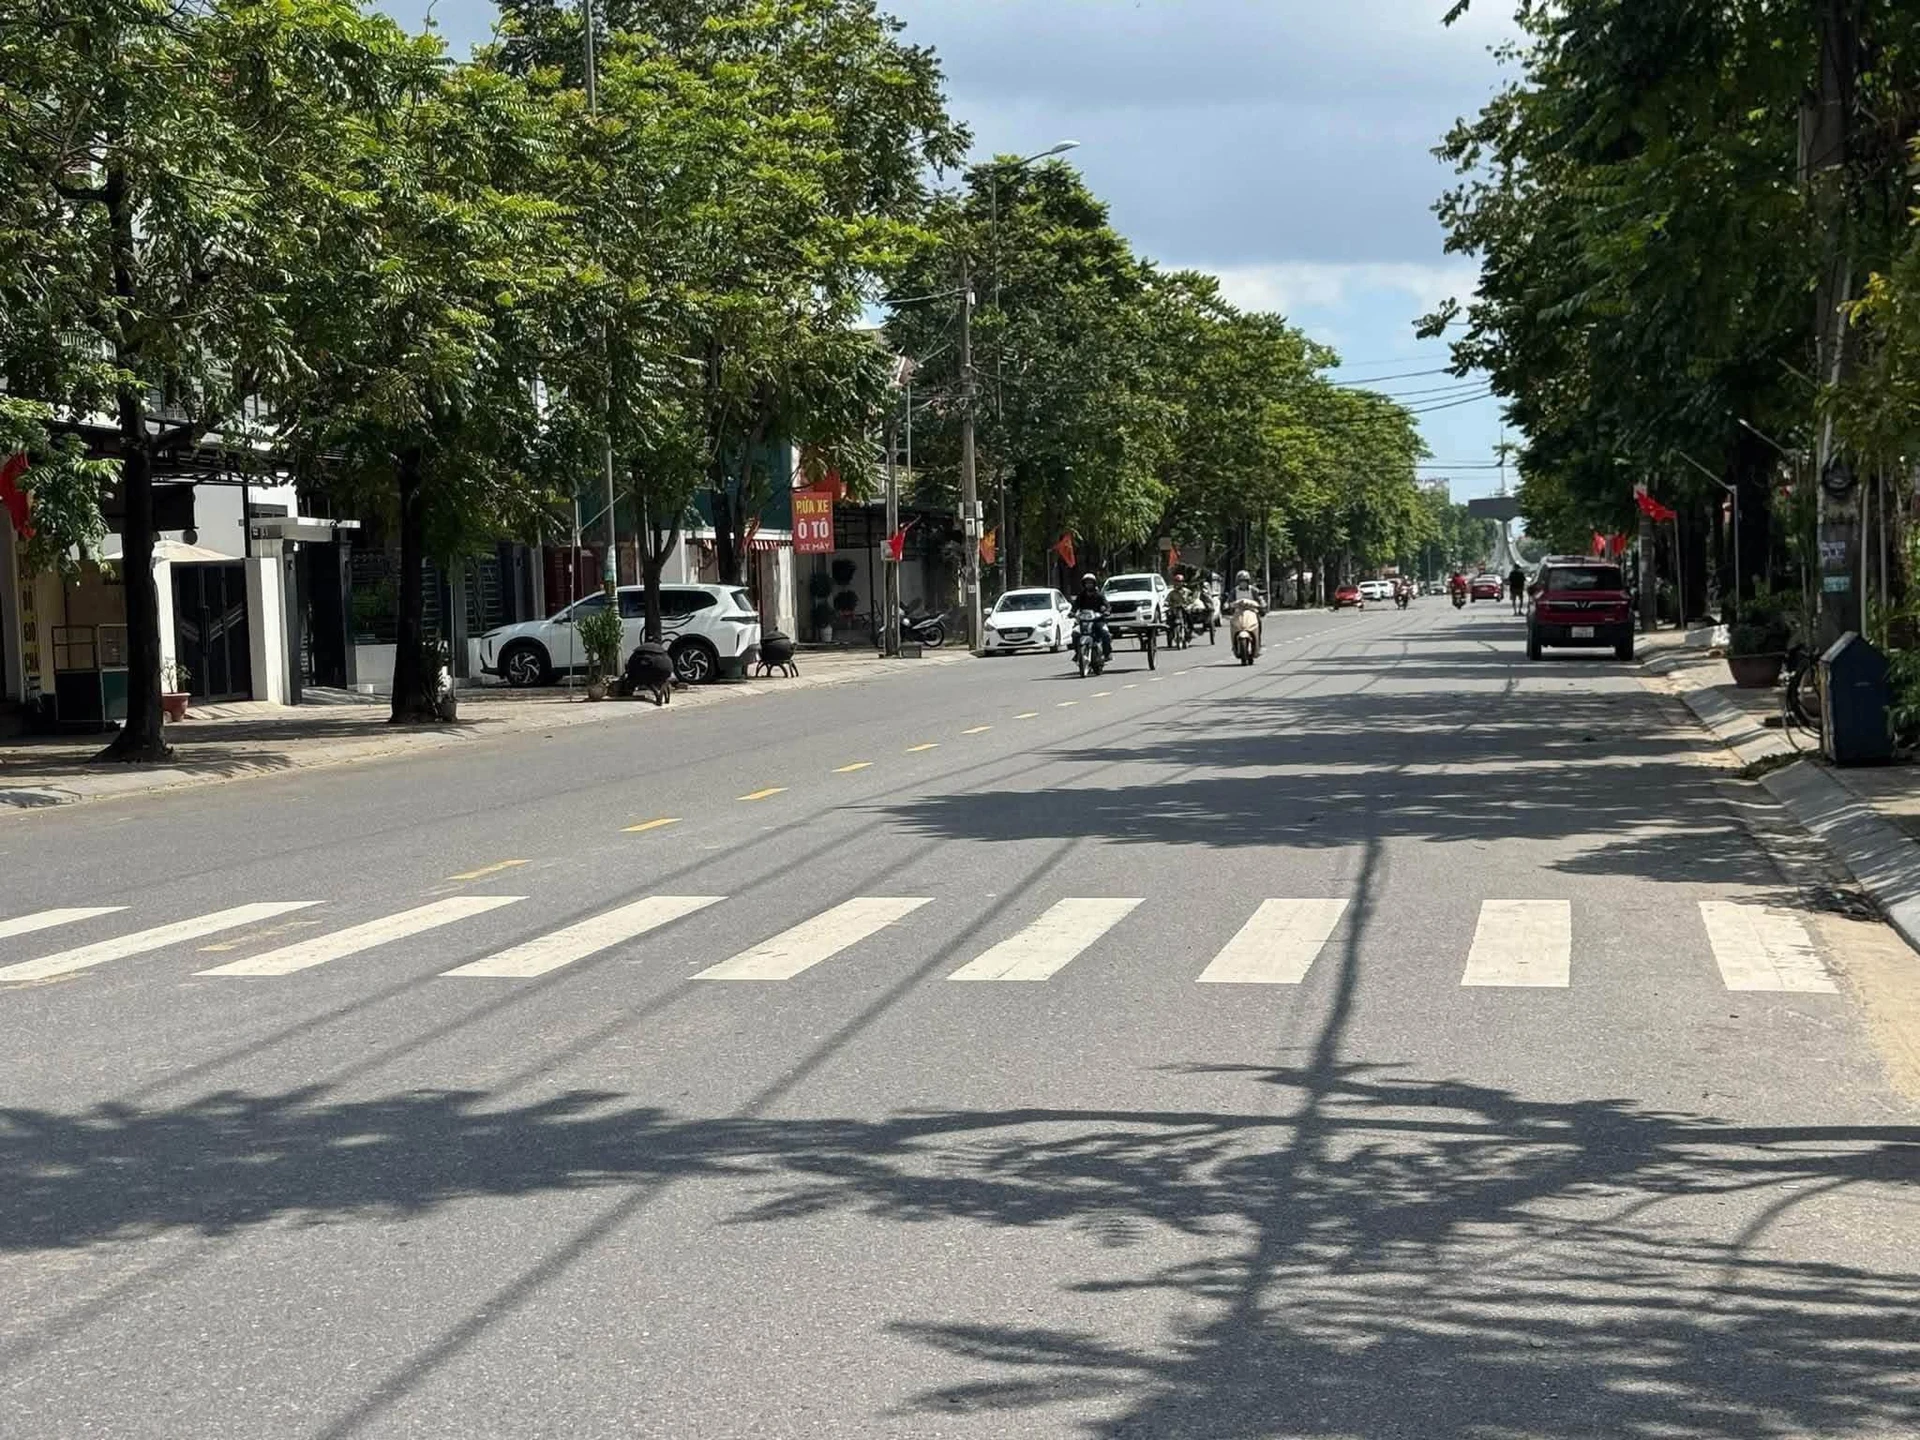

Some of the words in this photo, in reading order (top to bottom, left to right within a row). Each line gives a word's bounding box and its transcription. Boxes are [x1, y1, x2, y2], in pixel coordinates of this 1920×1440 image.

[796, 496, 814, 514] RỬA
[817, 499, 829, 513] XE
[798, 518, 808, 539] Ô
[811, 518, 829, 539] TÔ
